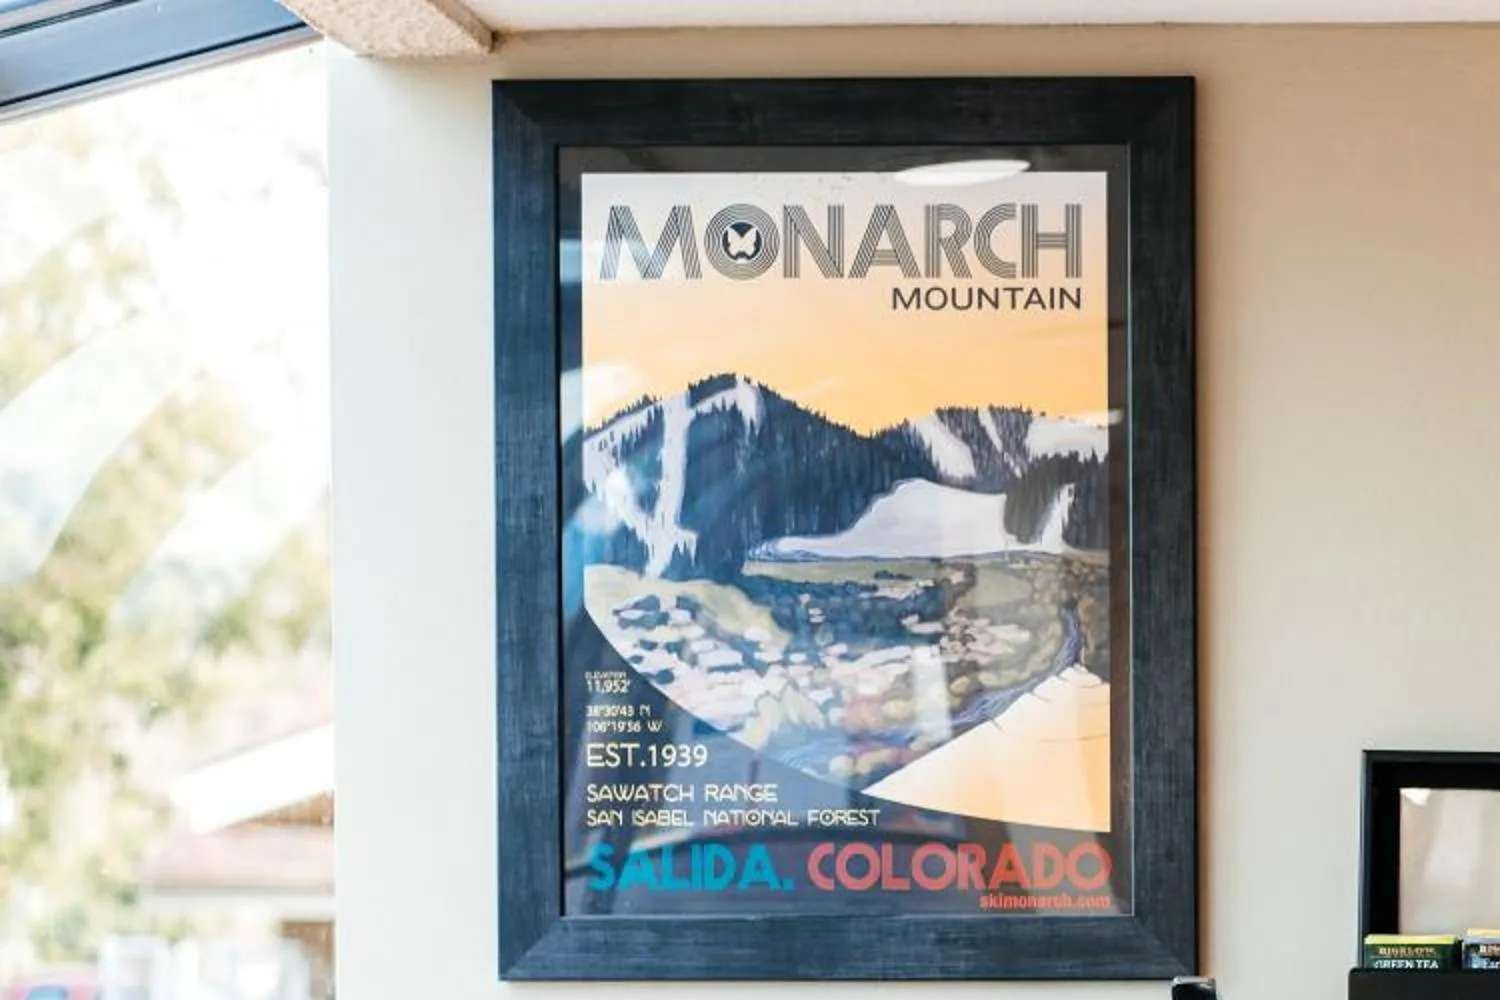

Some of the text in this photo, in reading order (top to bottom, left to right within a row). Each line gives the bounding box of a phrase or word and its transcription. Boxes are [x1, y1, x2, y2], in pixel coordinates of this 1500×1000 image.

[599, 203, 1082, 280] MONARCH
[892, 286, 1082, 311] MOUNTAIN
[587, 783, 778, 803] SAWATCH RANGE
[587, 808, 881, 827] SAN ISABEL NATIONAL FOREST
[807, 841, 1113, 892] COLORADO
[980, 893, 1111, 910] skimonarch.com
[1373, 959, 1439, 969] GREEN TEA
